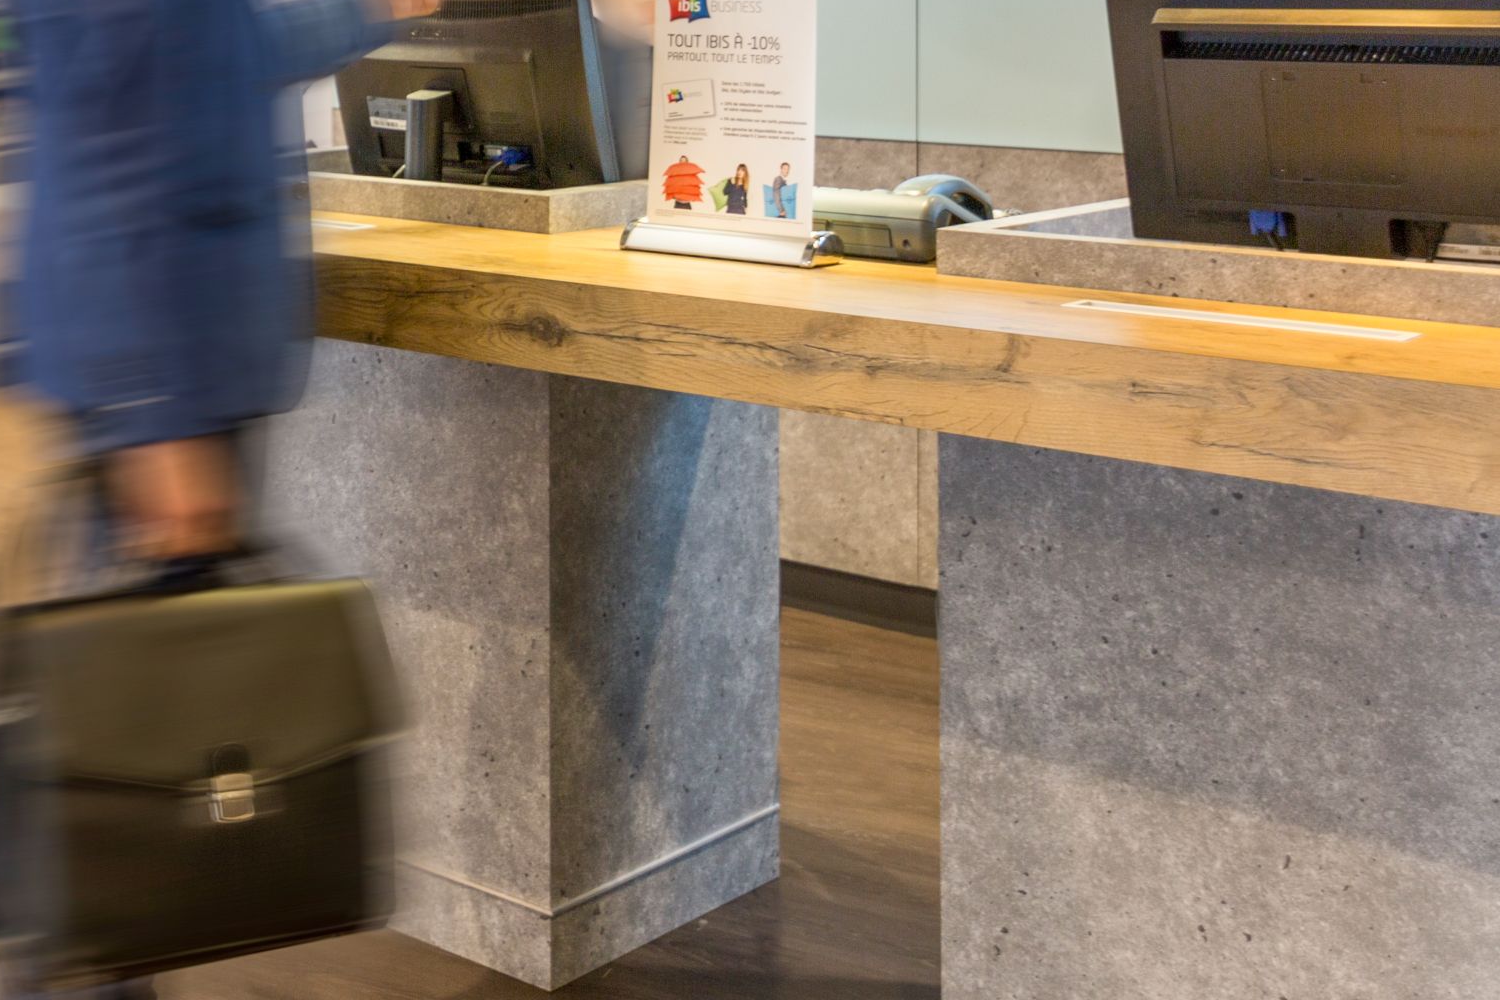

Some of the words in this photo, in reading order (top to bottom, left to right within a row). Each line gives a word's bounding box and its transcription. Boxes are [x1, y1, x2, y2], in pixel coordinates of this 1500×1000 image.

[711, 0, 762, 13] BUSINESS
[667, 33, 702, 48] TOUT
[706, 34, 730, 49] IBIS
[734, 32, 743, 49] À
[747, 36, 781, 51] -10%
[667, 51, 709, 63] PARTOUT,
[712, 53, 735, 63] TOUT
[736, 53, 748, 64] LE
